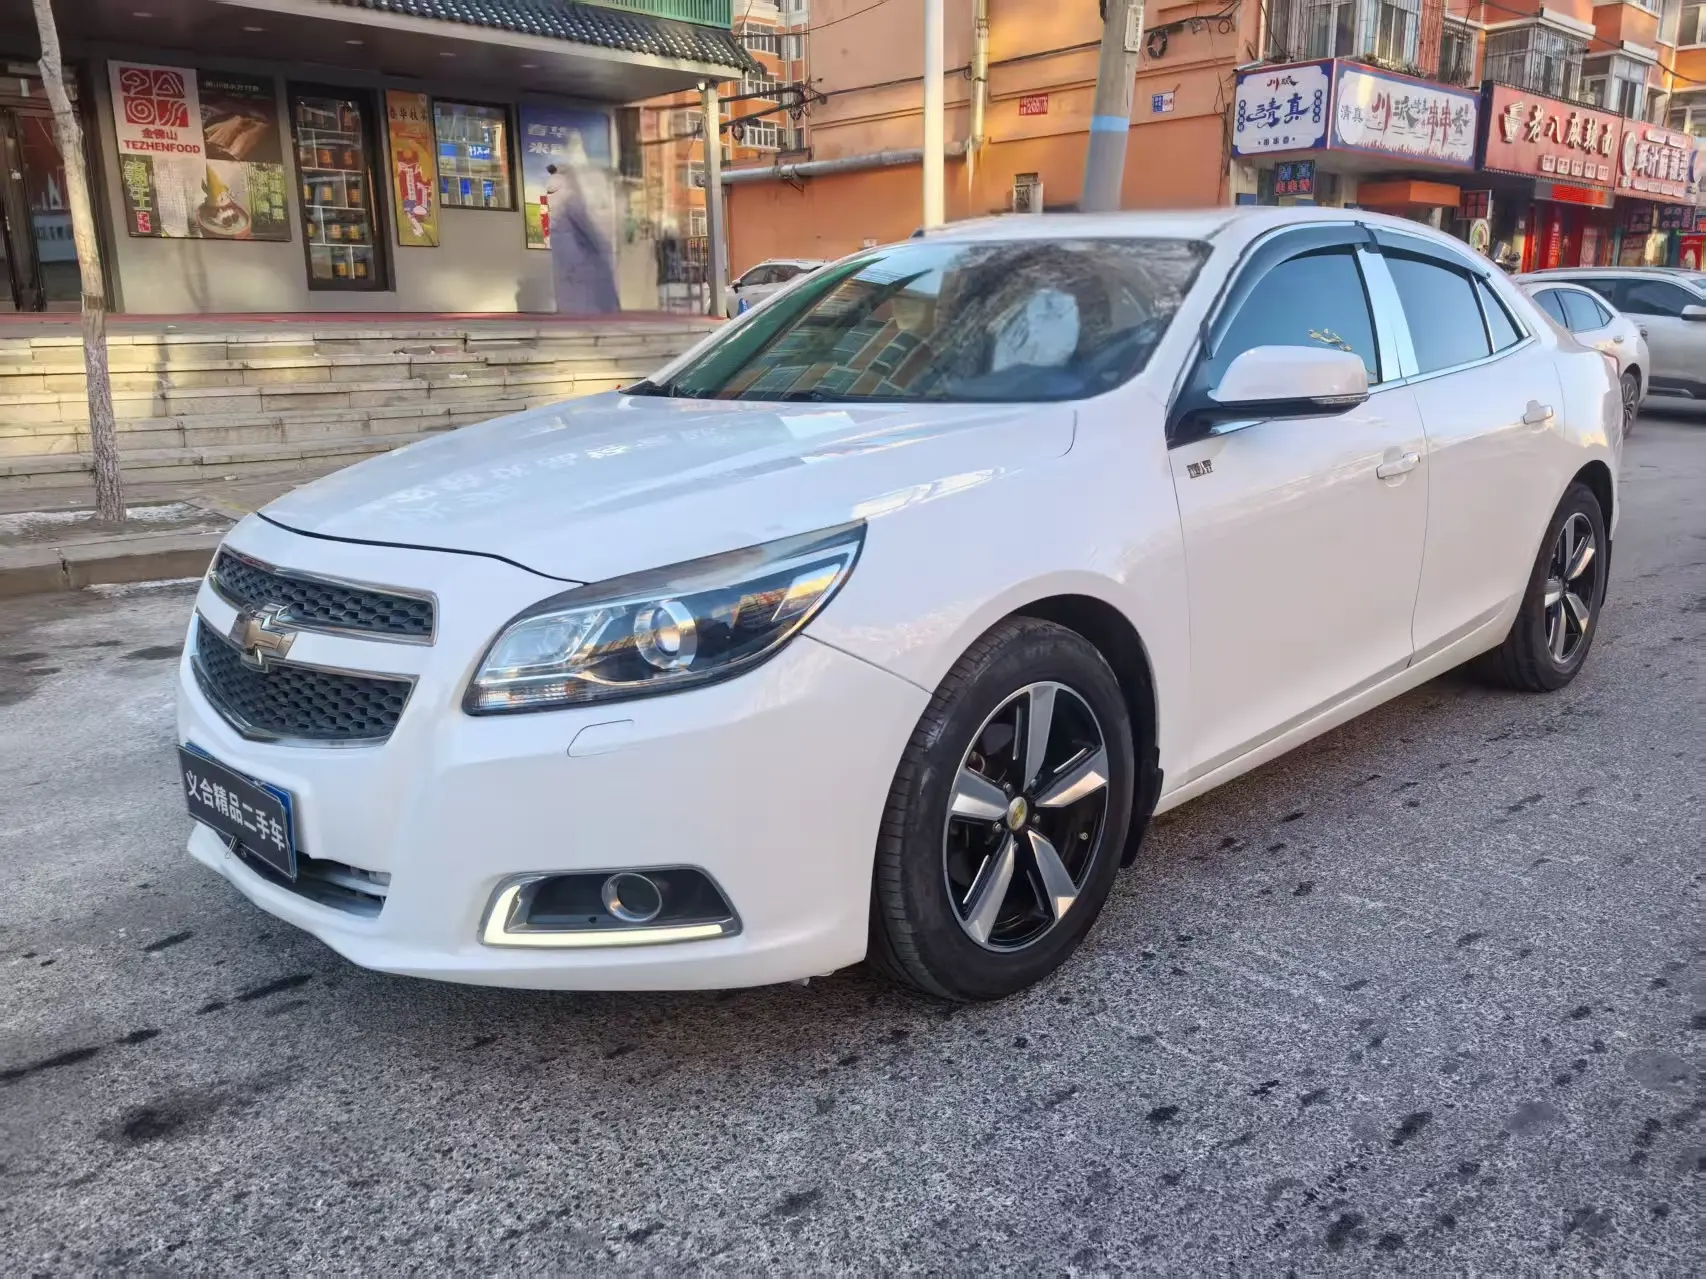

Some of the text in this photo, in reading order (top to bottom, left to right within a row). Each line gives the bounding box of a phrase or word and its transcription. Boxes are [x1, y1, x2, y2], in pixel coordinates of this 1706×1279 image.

[1246, 92, 1311, 128] 清真
[1340, 104, 1363, 123] 清真
[123, 140, 201, 154] TEZHENFOOD
[185, 770, 286, 852] 义合精品二手车
